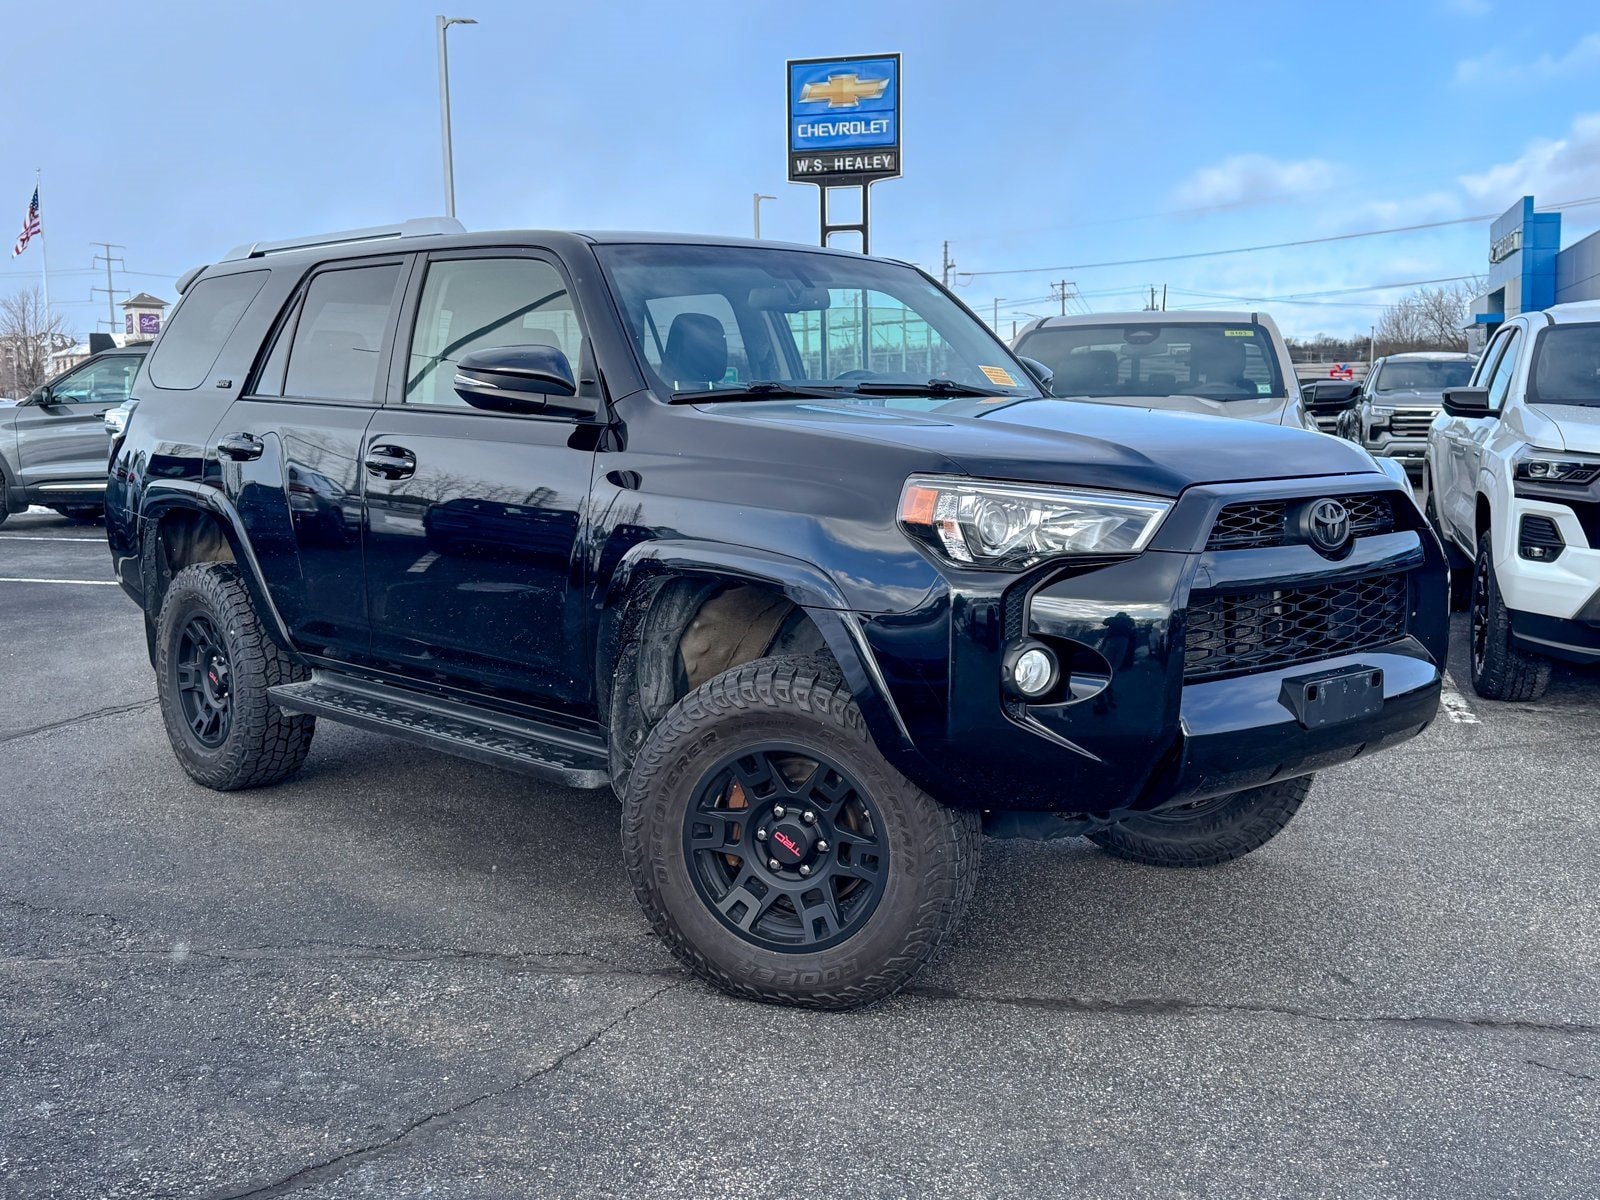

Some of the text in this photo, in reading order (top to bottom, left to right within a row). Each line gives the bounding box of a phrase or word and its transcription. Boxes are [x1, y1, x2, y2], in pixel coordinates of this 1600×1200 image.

[797, 119, 890, 138] CHEVROLET
[796, 155, 891, 172] W.S. HEALEY
[649, 730, 719, 885] DISCOVERER
[774, 831, 801, 857] TRD
[732, 957, 859, 988] COOPER
